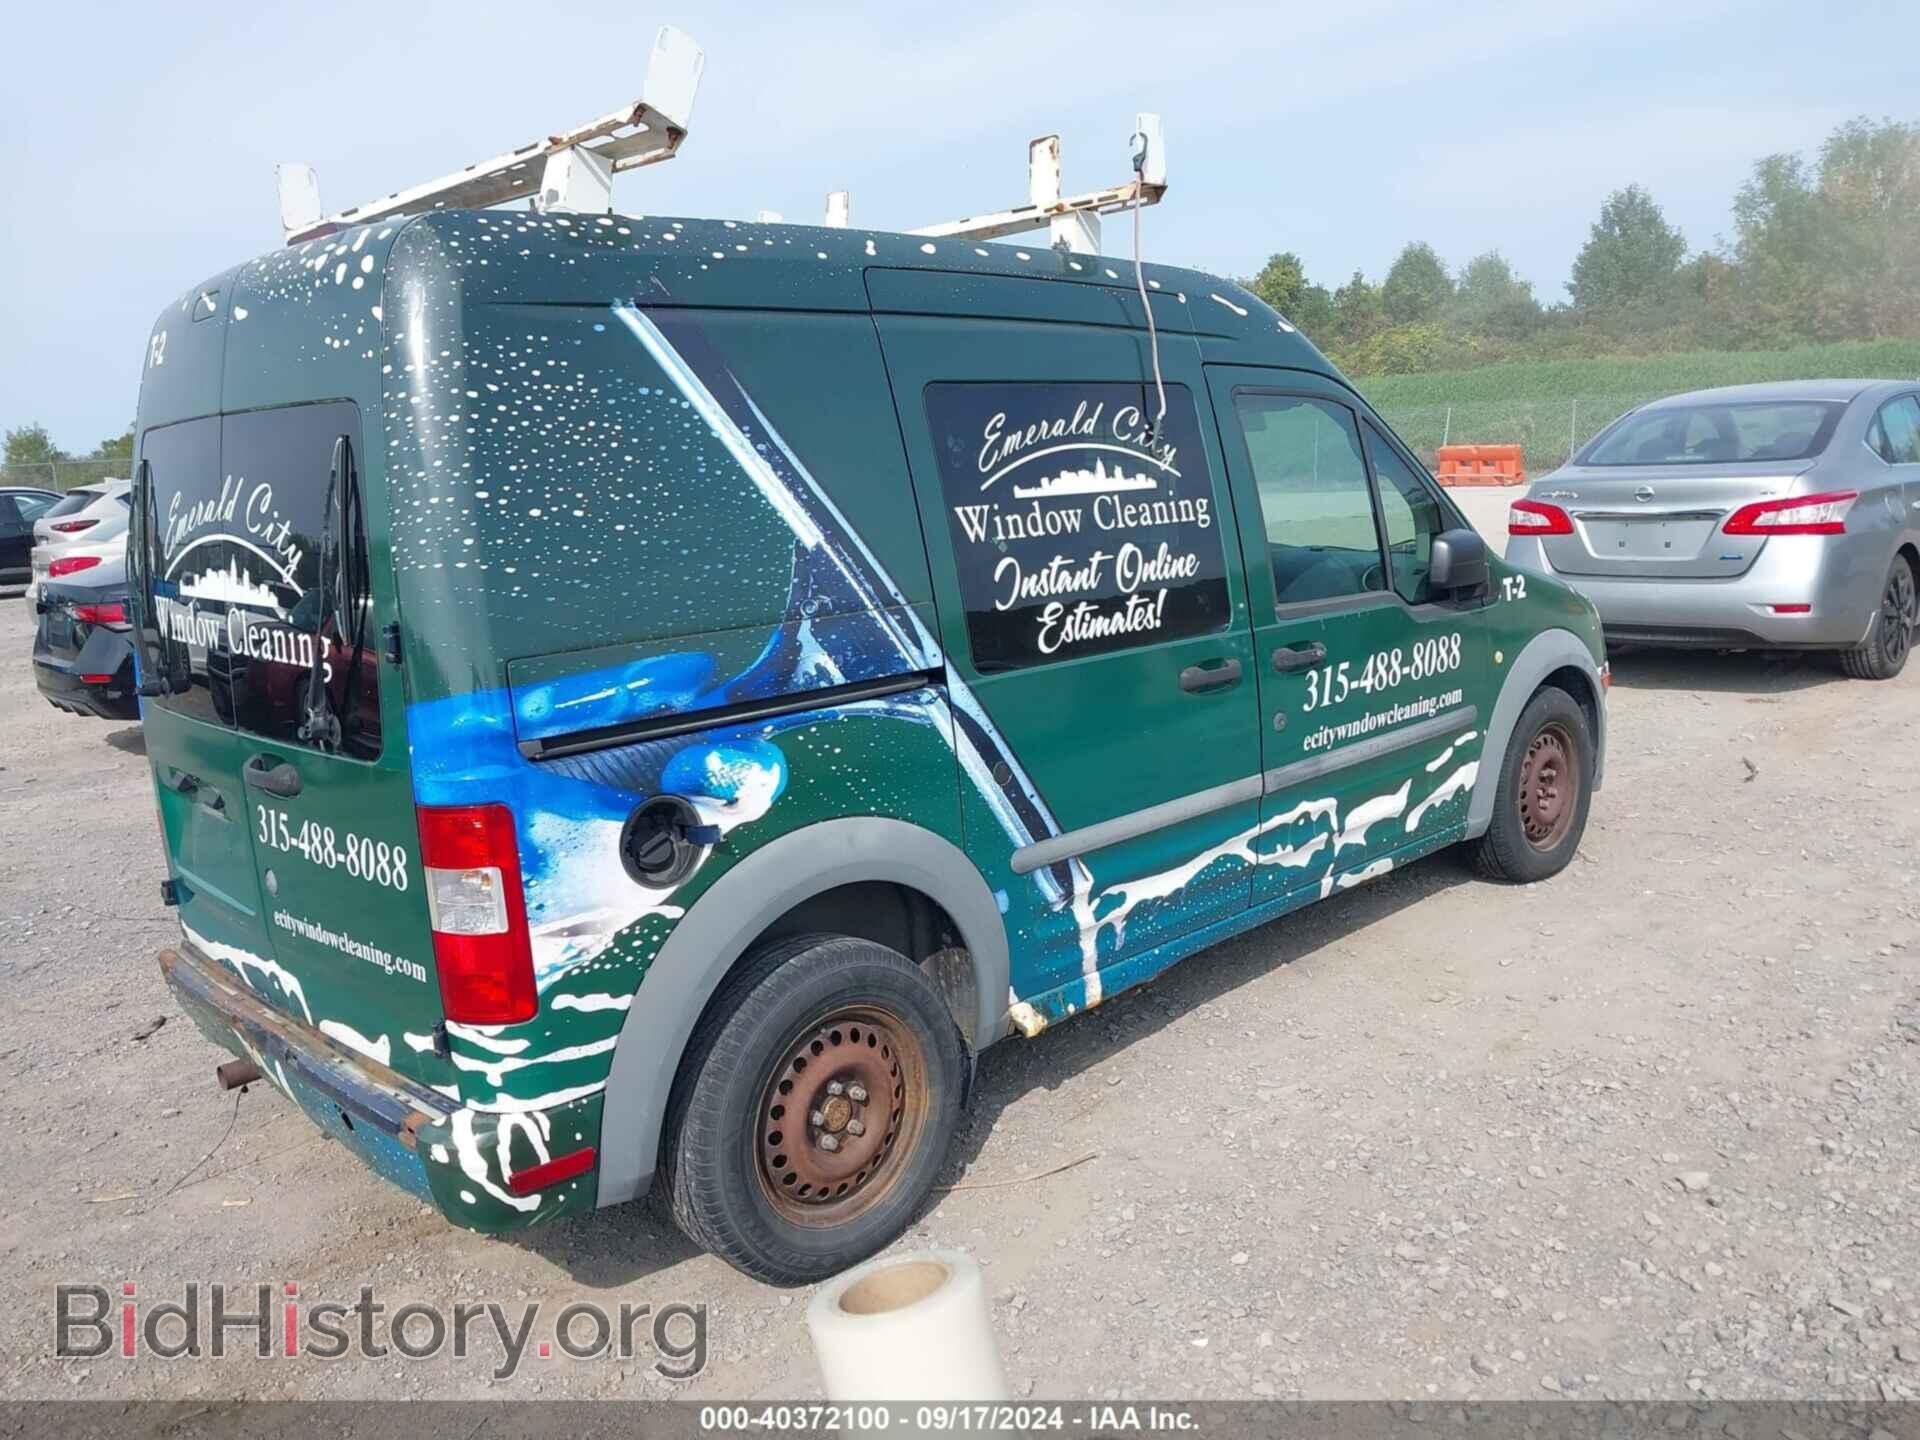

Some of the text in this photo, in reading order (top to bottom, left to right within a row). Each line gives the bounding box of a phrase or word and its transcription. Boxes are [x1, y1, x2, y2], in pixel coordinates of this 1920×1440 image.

[979, 400, 1104, 472] Emerald
[165, 474, 303, 584] Emerald City
[953, 489, 1211, 544] Window Cleaning
[994, 542, 1201, 611] Instant Online
[1502, 574, 1527, 601] T-2
[153, 595, 220, 651] Window
[1036, 588, 1168, 654] Estimates!
[1302, 632, 1462, 713] 315-488-8088
[1302, 688, 1463, 752] ecitywindowcleaning.com
[257, 804, 408, 892] 315-488-8088
[273, 908, 427, 983] ecitywindowcleaning.com
